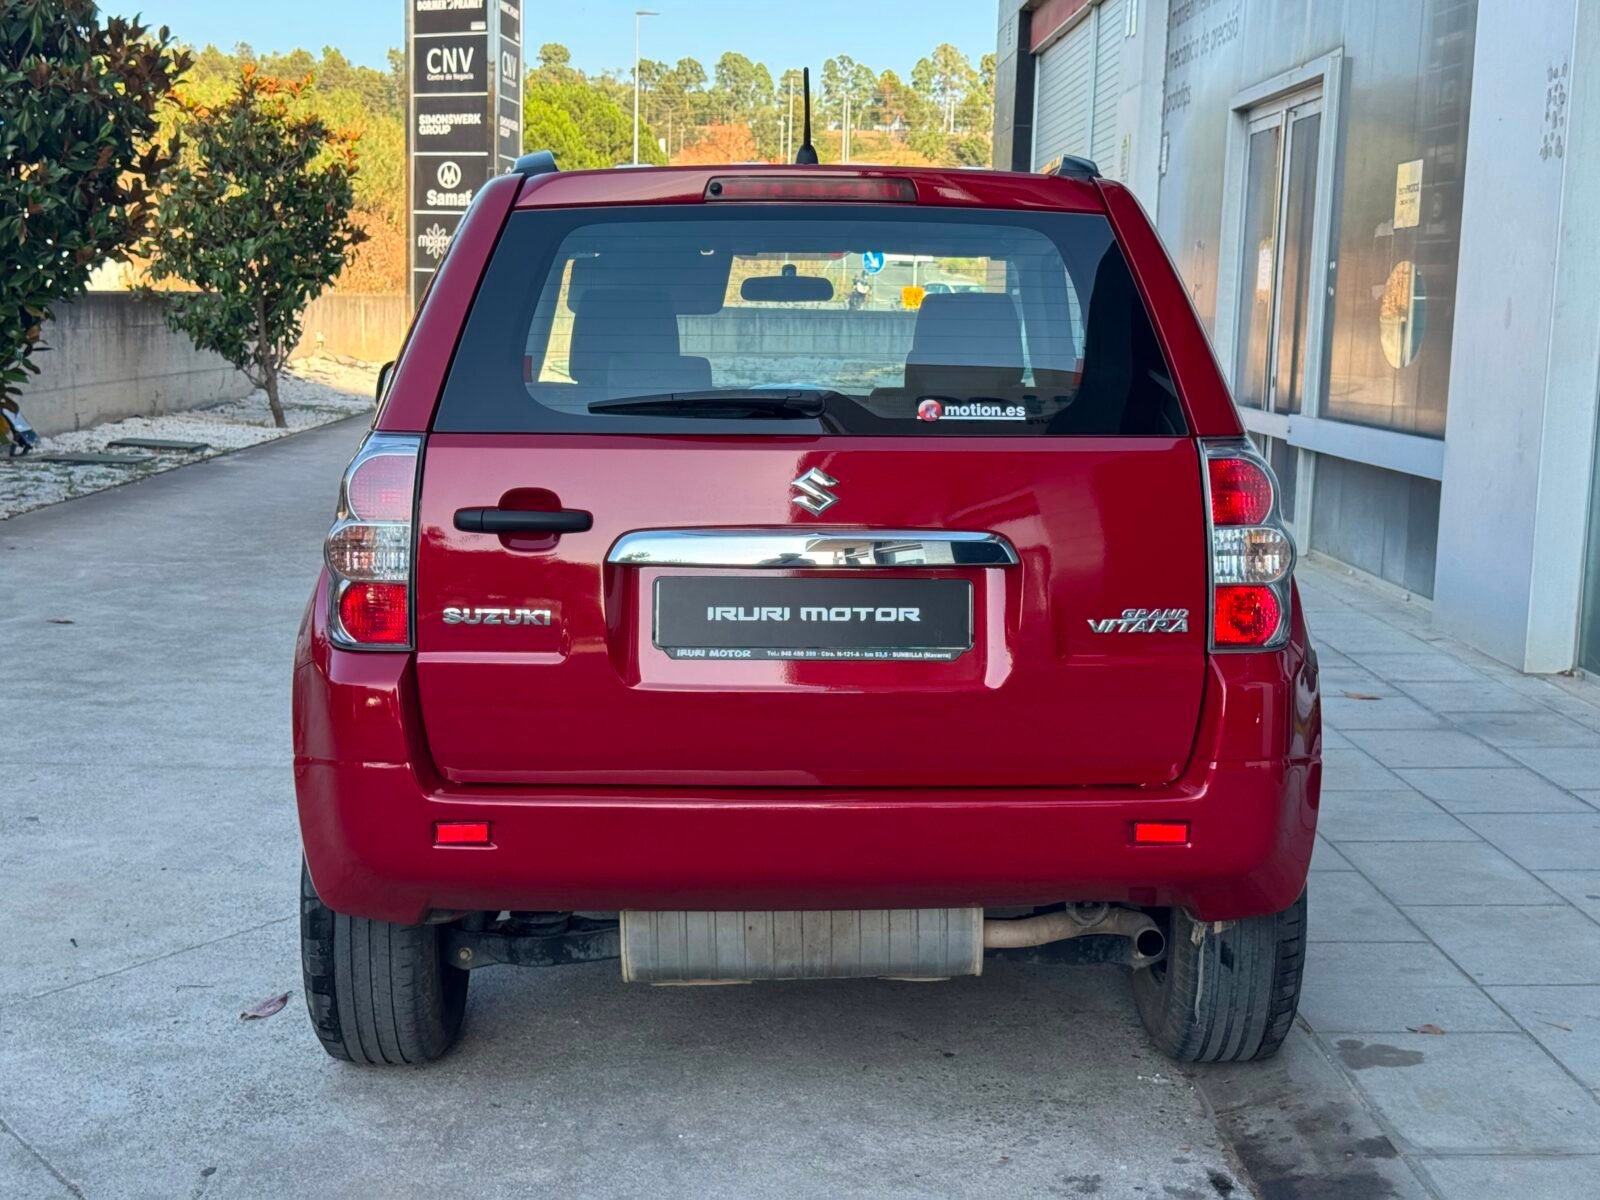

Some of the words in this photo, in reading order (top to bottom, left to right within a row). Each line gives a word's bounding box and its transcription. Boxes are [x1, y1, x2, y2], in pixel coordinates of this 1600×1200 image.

[426, 47, 474, 73] CNV
[502, 51, 517, 80] CNV
[418, 113, 481, 125] SIMONSWERK
[418, 124, 451, 135] GROUP
[944, 403, 1026, 416] motion.es
[442, 607, 552, 625] SUZUKI
[707, 606, 791, 622] IRURI
[799, 607, 921, 622] MOTOR
[1121, 608, 1190, 619] GRAND
[1087, 618, 1189, 633] VITARA
[676, 648, 706, 657] IRURI
[708, 648, 752, 658] MOTOR
